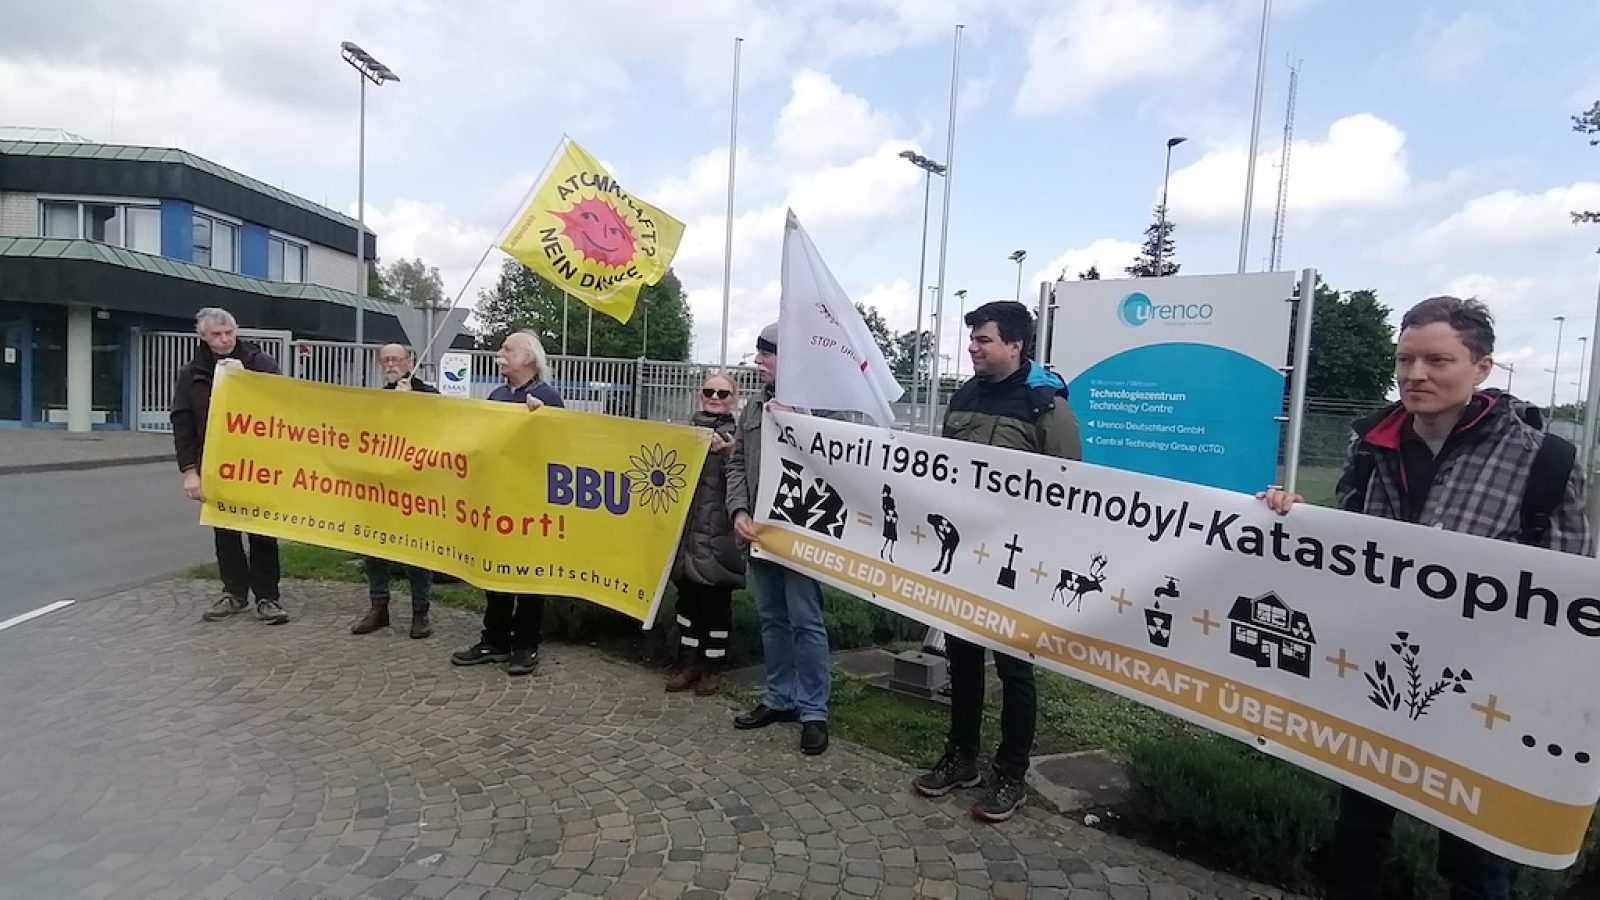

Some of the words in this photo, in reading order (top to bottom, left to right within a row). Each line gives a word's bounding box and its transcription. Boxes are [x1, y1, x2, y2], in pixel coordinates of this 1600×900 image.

[539, 227, 578, 280] NEIN
[810, 335, 837, 348] STOP
[1089, 388, 1187, 401] Technologiezentrum
[1089, 400, 1139, 414] Technology
[1140, 402, 1174, 414] Centre
[226, 412, 350, 450] Weltweite
[358, 430, 469, 479] Stilllegung
[1095, 436, 1124, 446] Central
[1125, 438, 1170, 452] Technology
[1170, 441, 1198, 453] Group
[1198, 443, 1226, 455] (CTG)
[1096, 420, 1125, 430] Urenco
[1126, 421, 1176, 434] Deutschland
[1177, 424, 1206, 435] GmbH
[218, 459, 283, 485] aller
[292, 468, 447, 519] Atomanlagen!
[456, 499, 566, 540] Sofort!
[547, 463, 631, 516] BBU
[217, 501, 346, 534] Bundesverband
[354, 524, 476, 568] Bürgerinitiativen
[482, 559, 629, 594] Umweltschutz
[810, 431, 873, 466] April
[882, 443, 959, 484] 1986:
[970, 460, 1600, 638] Tschernobyl-Katastrophe
[791, 539, 846, 574] NEUES
[847, 559, 888, 588] LEID
[891, 572, 1018, 641] VERHINDERN
[1035, 631, 1210, 704] ATOMKRAFT
[1217, 682, 1483, 816] ÜBERWINDEN
